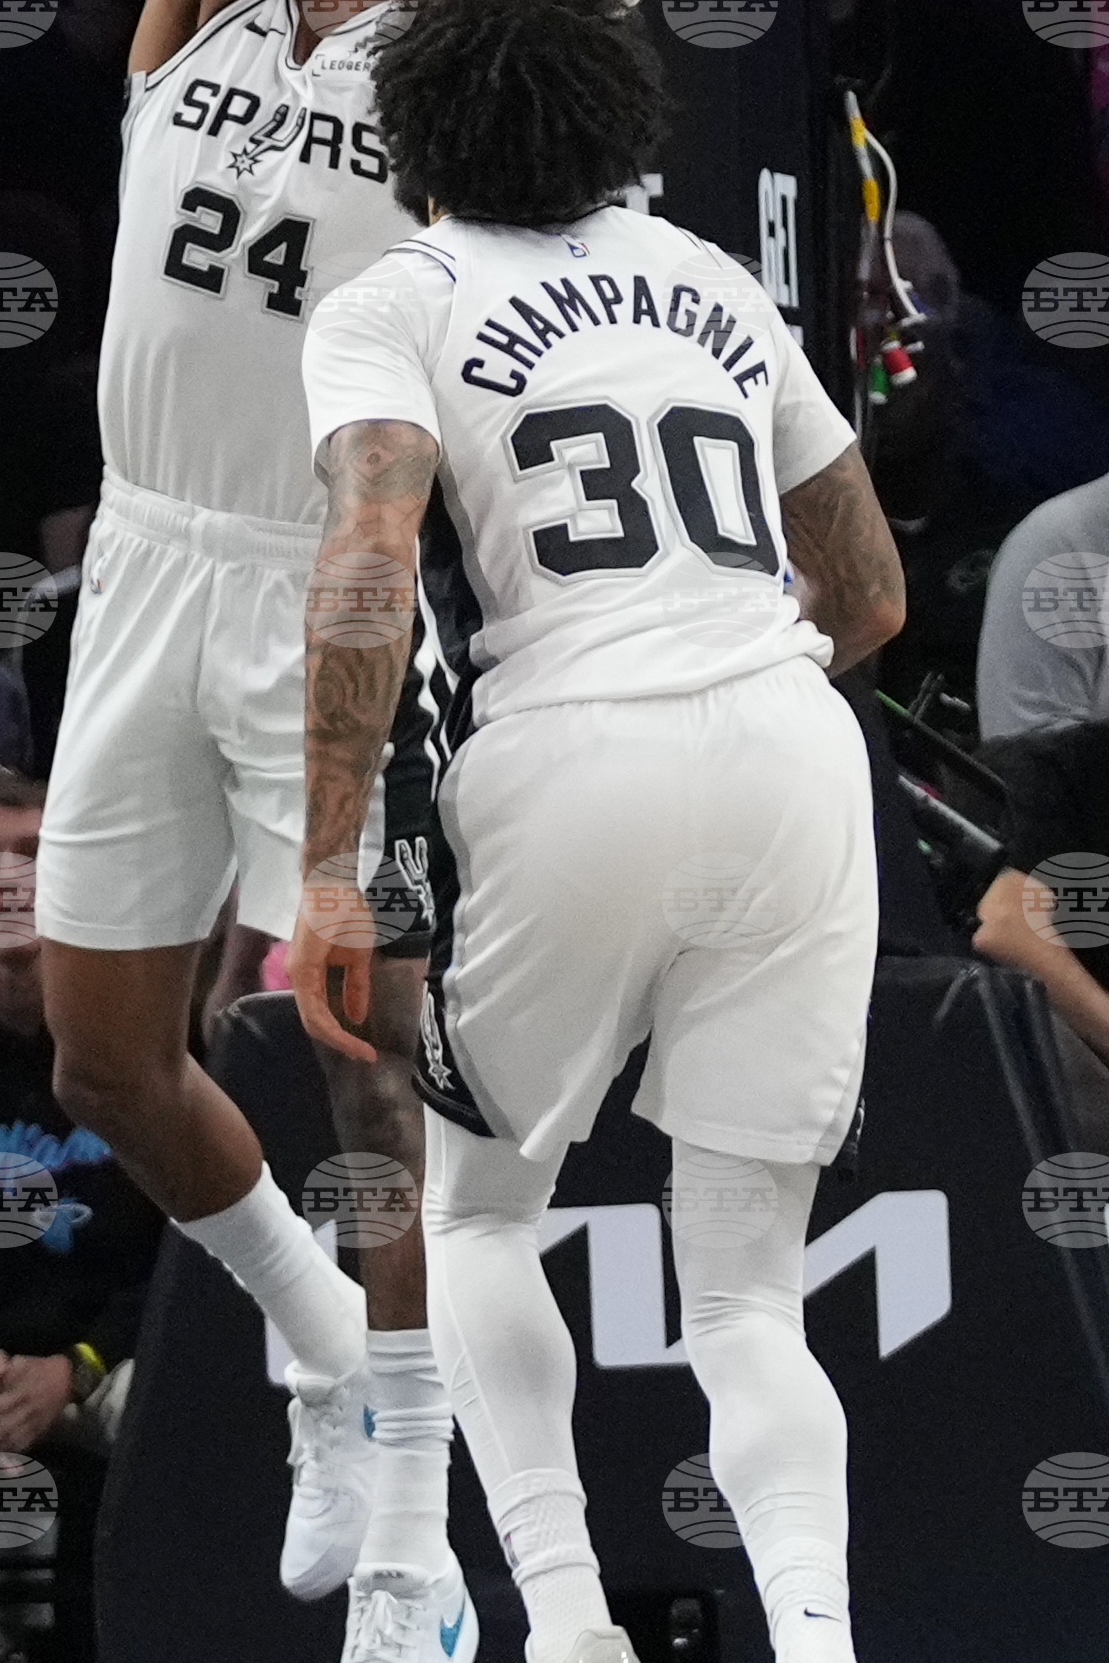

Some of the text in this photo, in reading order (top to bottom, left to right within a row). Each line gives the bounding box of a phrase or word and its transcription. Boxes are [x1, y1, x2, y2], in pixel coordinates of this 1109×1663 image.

[172, 78, 390, 184] SPURS
[321, 59, 371, 72] LEDGER
[161, 182, 315, 323] 24
[757, 167, 799, 308] GET
[461, 273, 770, 400] CHAMPAGNIE
[502, 396, 788, 586] 30
